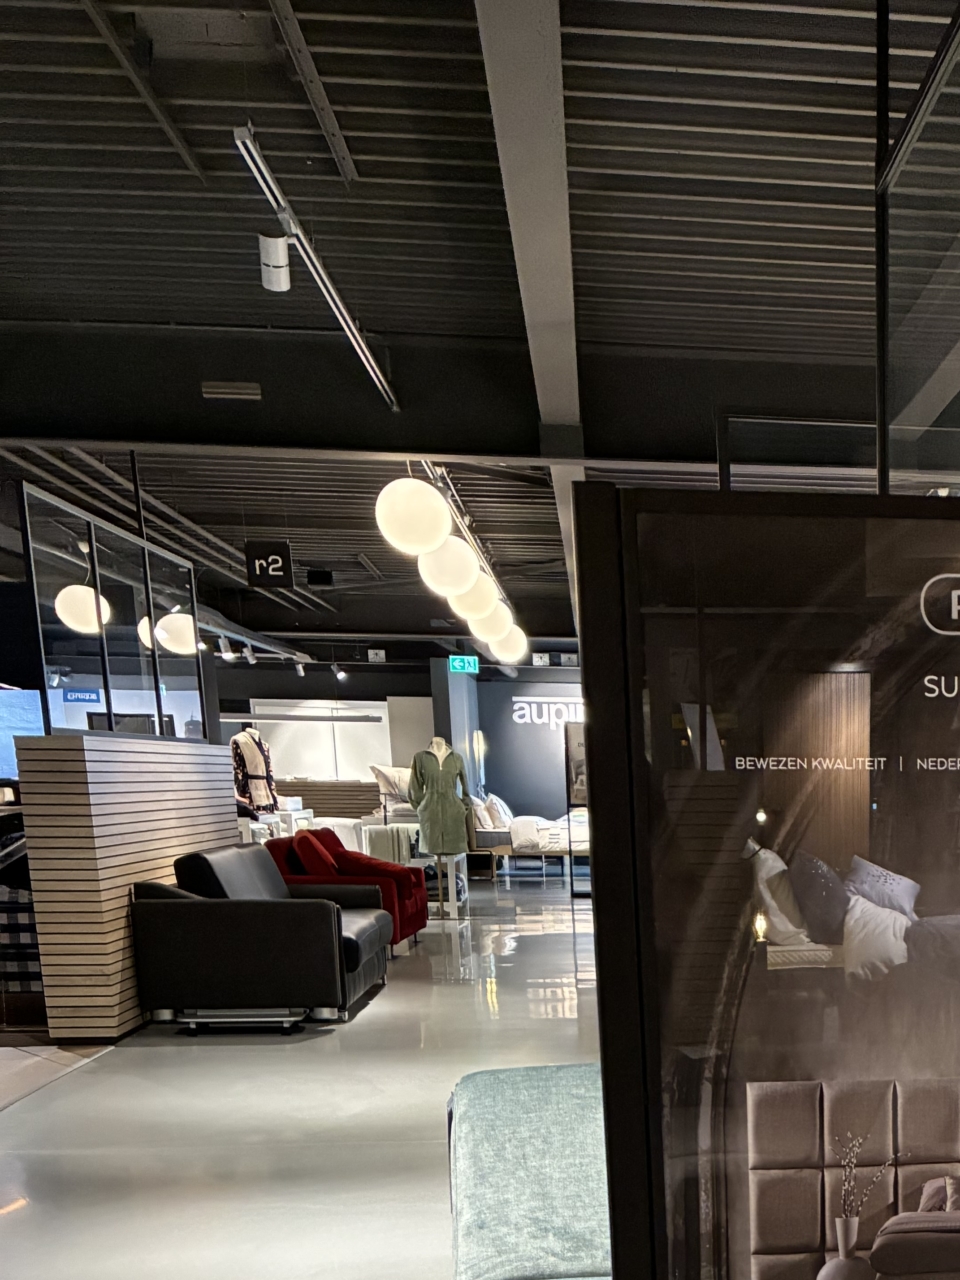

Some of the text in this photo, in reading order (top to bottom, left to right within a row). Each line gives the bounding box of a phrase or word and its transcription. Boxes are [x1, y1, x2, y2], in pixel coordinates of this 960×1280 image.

[254, 554, 284, 576] r2
[735, 756, 808, 770] BEWEZEN
[811, 756, 887, 770] KWALITEIT
